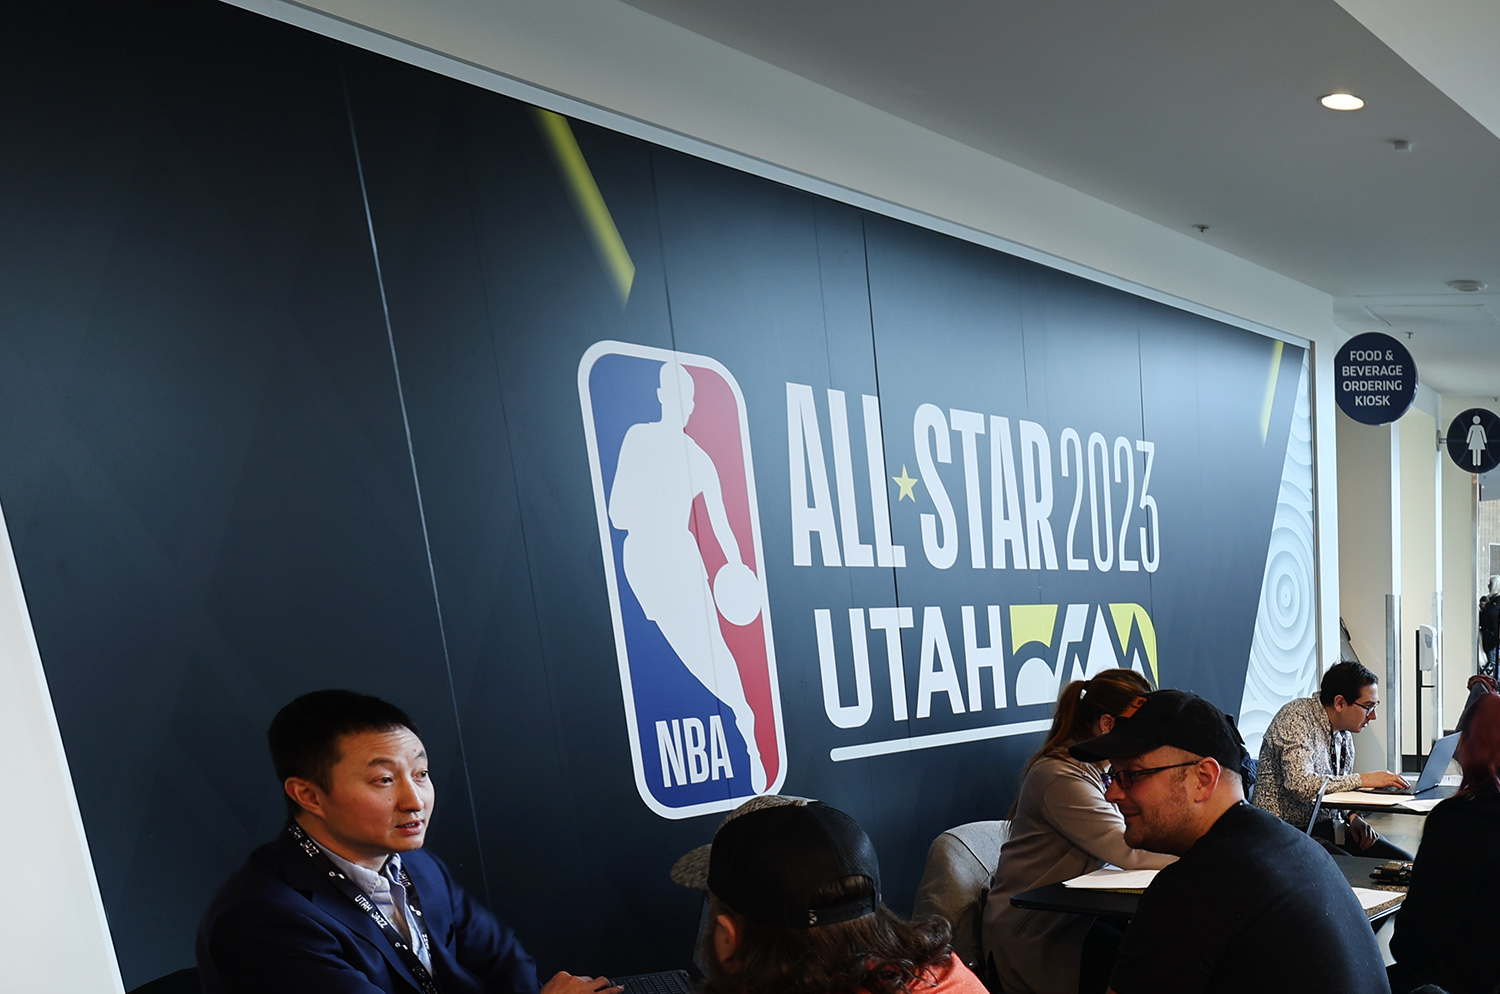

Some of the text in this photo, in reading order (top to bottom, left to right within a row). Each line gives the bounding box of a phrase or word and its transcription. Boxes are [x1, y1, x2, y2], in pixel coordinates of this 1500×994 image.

[1350, 350, 1394, 361] FOOD &
[1342, 365, 1403, 376] BEVERAGE
[1342, 380, 1403, 392] ORDERING
[1355, 395, 1390, 406] KIOSK
[785, 382, 1161, 573] ALL STAR 2023
[814, 604, 1008, 729] UTAH
[655, 714, 735, 788] NBA
[300, 839, 319, 857] JAZZ
[354, 894, 388, 929] UTAH JAZZ
